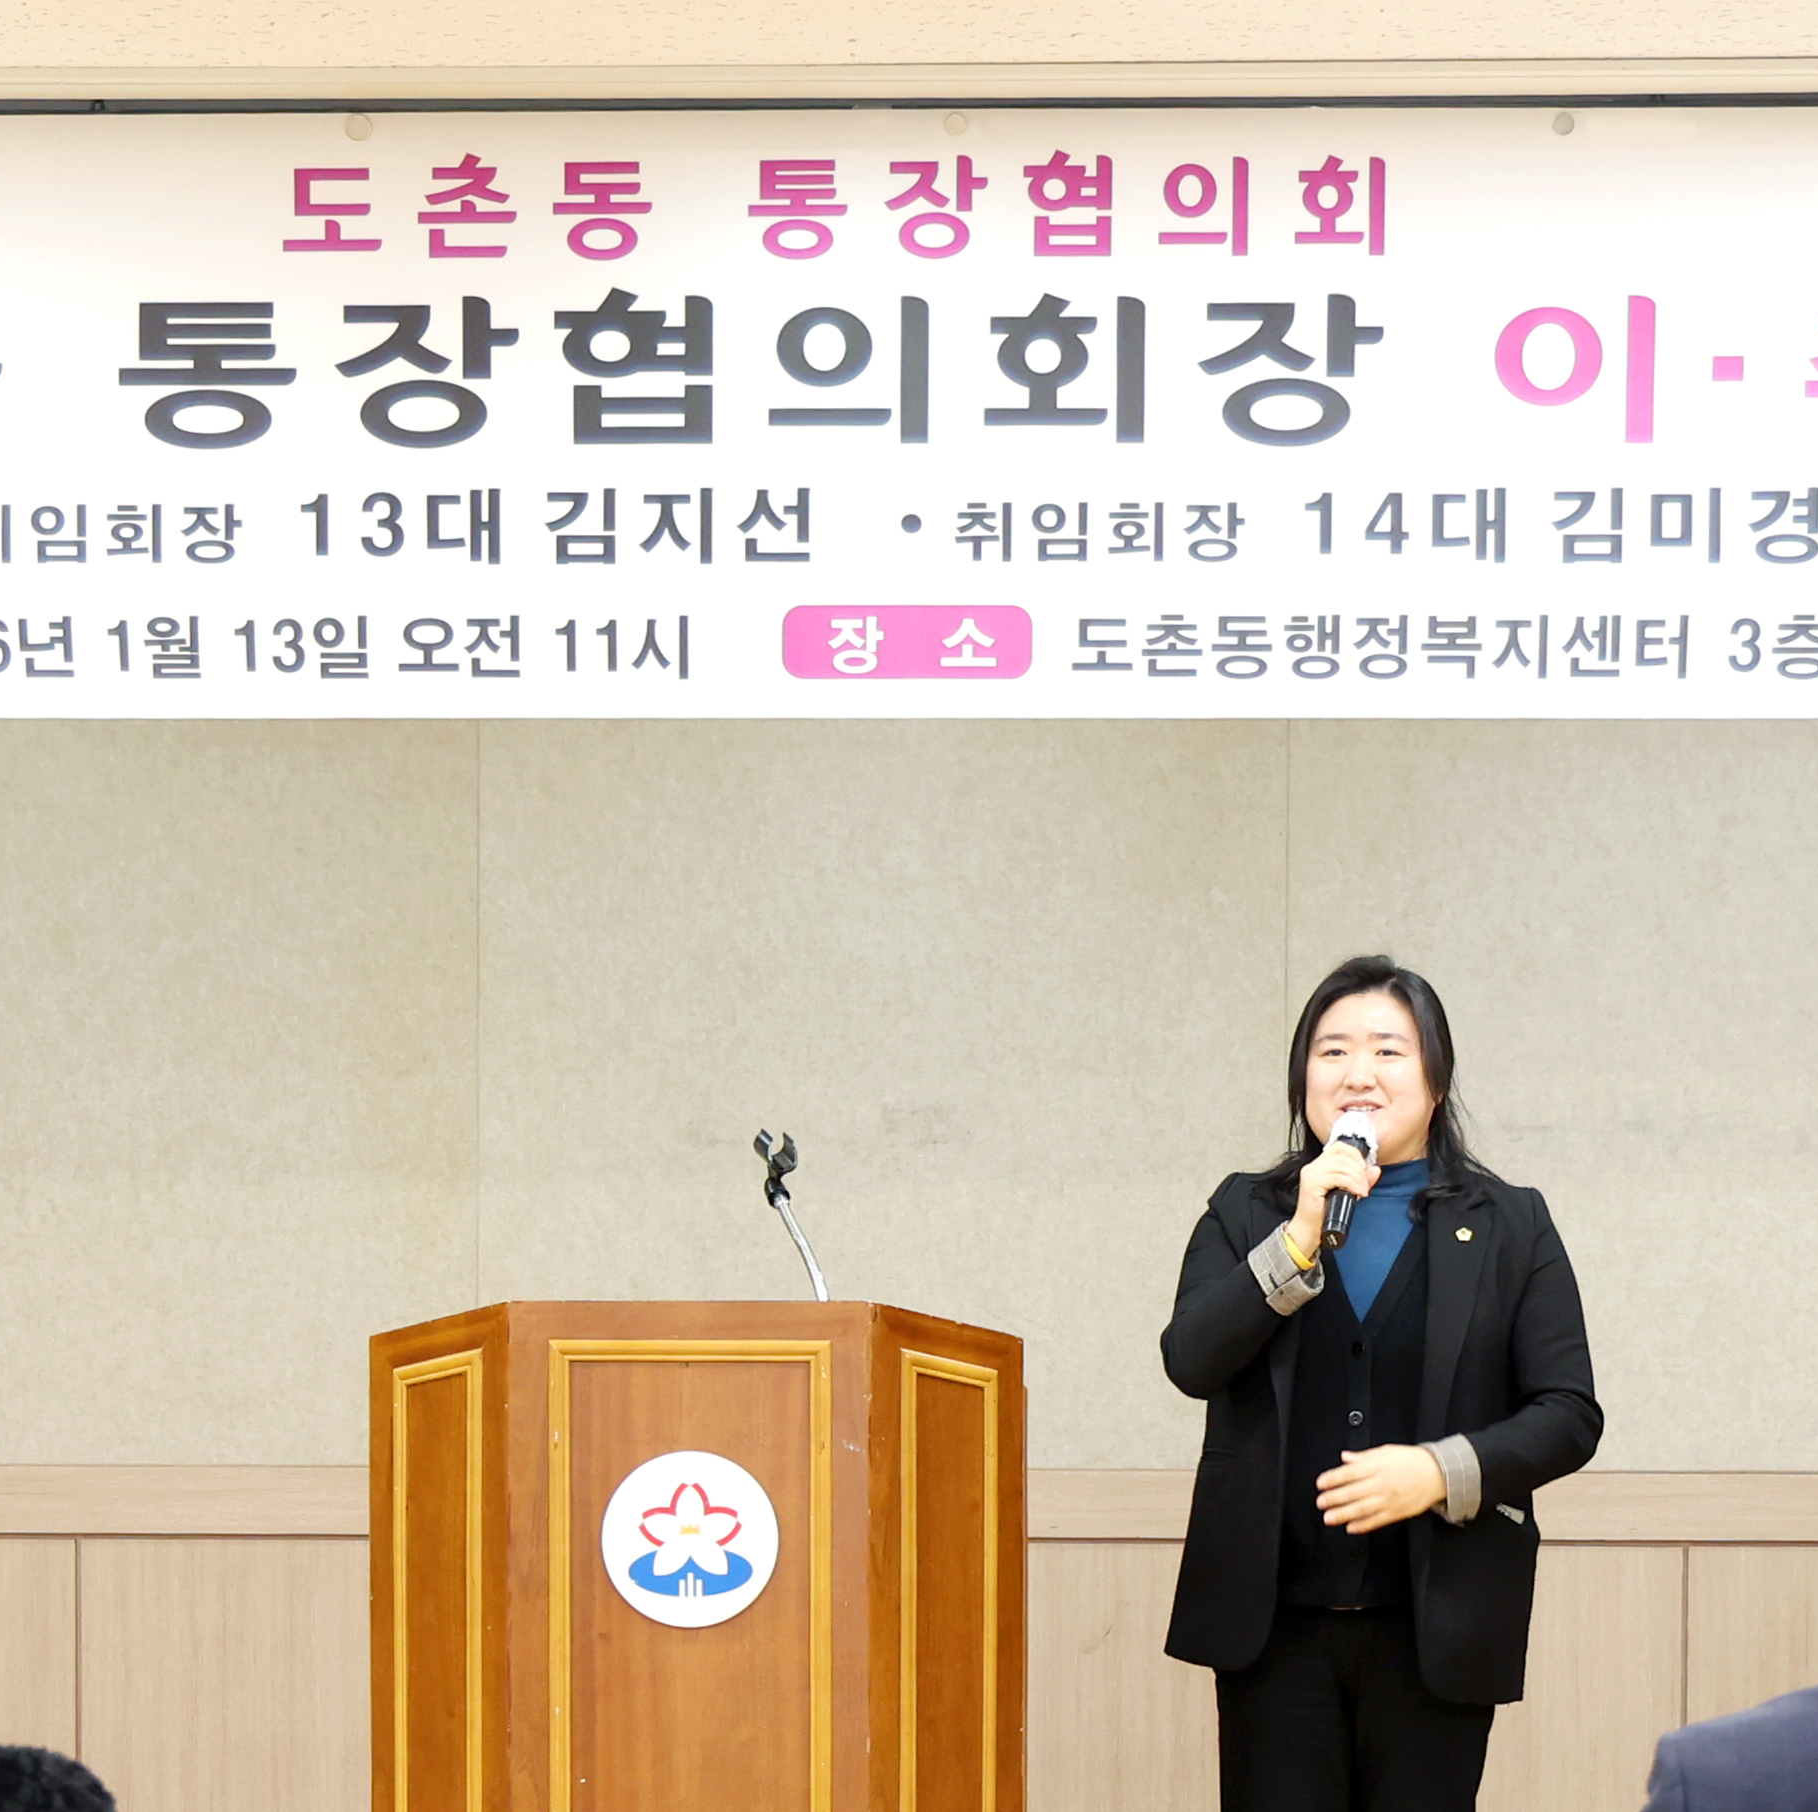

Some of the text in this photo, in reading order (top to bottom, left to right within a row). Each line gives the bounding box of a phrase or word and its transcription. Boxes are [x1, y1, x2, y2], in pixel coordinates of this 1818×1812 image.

[281, 150, 1387, 260] 도촌동 통장협의회
[118, 286, 1386, 450] 통장협의회장
[300, 491, 501, 565] 13대
[546, 487, 810, 565] 김지선
[955, 502, 1245, 562] 취임회장
[1305, 487, 1506, 563] 14대
[107, 615, 201, 679] 1월
[234, 615, 369, 679] 13일
[398, 615, 520, 678] 오전
[555, 615, 689, 680] 11시
[1072, 614, 1689, 679] 도촌동행정복지센터
